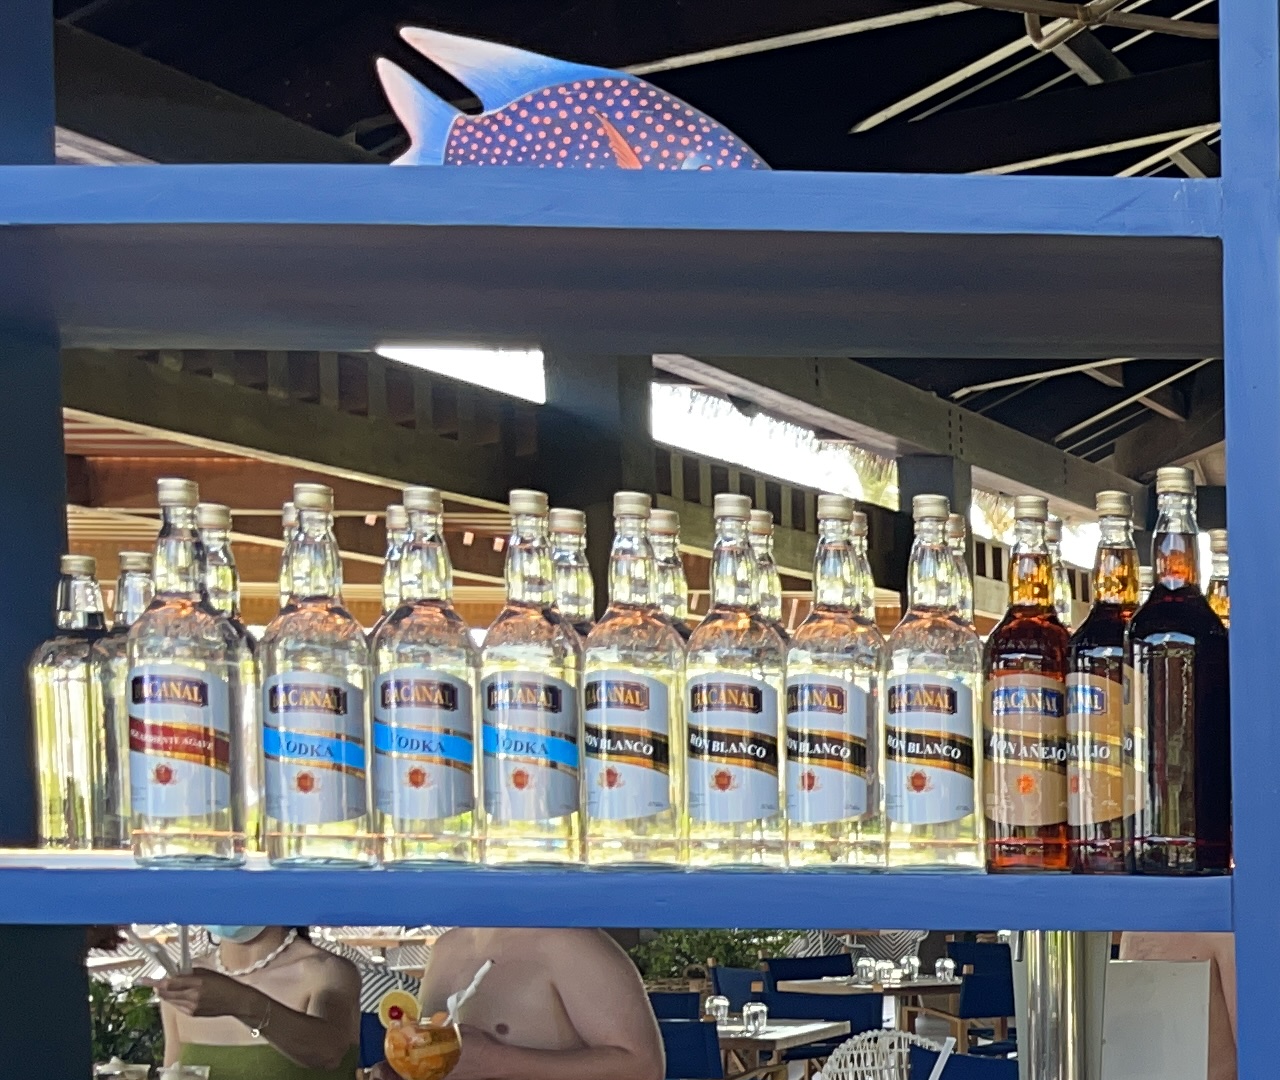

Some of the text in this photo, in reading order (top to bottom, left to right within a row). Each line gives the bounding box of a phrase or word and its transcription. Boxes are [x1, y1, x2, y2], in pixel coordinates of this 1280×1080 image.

[693, 687, 757, 711] BACANAL
[280, 738, 335, 758] VODKA
[390, 733, 446, 753] VODKA
[496, 735, 550, 755] VODKA
[599, 738, 655, 756] BLANCO
[690, 733, 766, 760] RON BLANCO
[799, 742, 851, 759] BLANCO
[908, 742, 961, 760] BLANCO
[1018, 739, 1066, 761] AÑEJO
